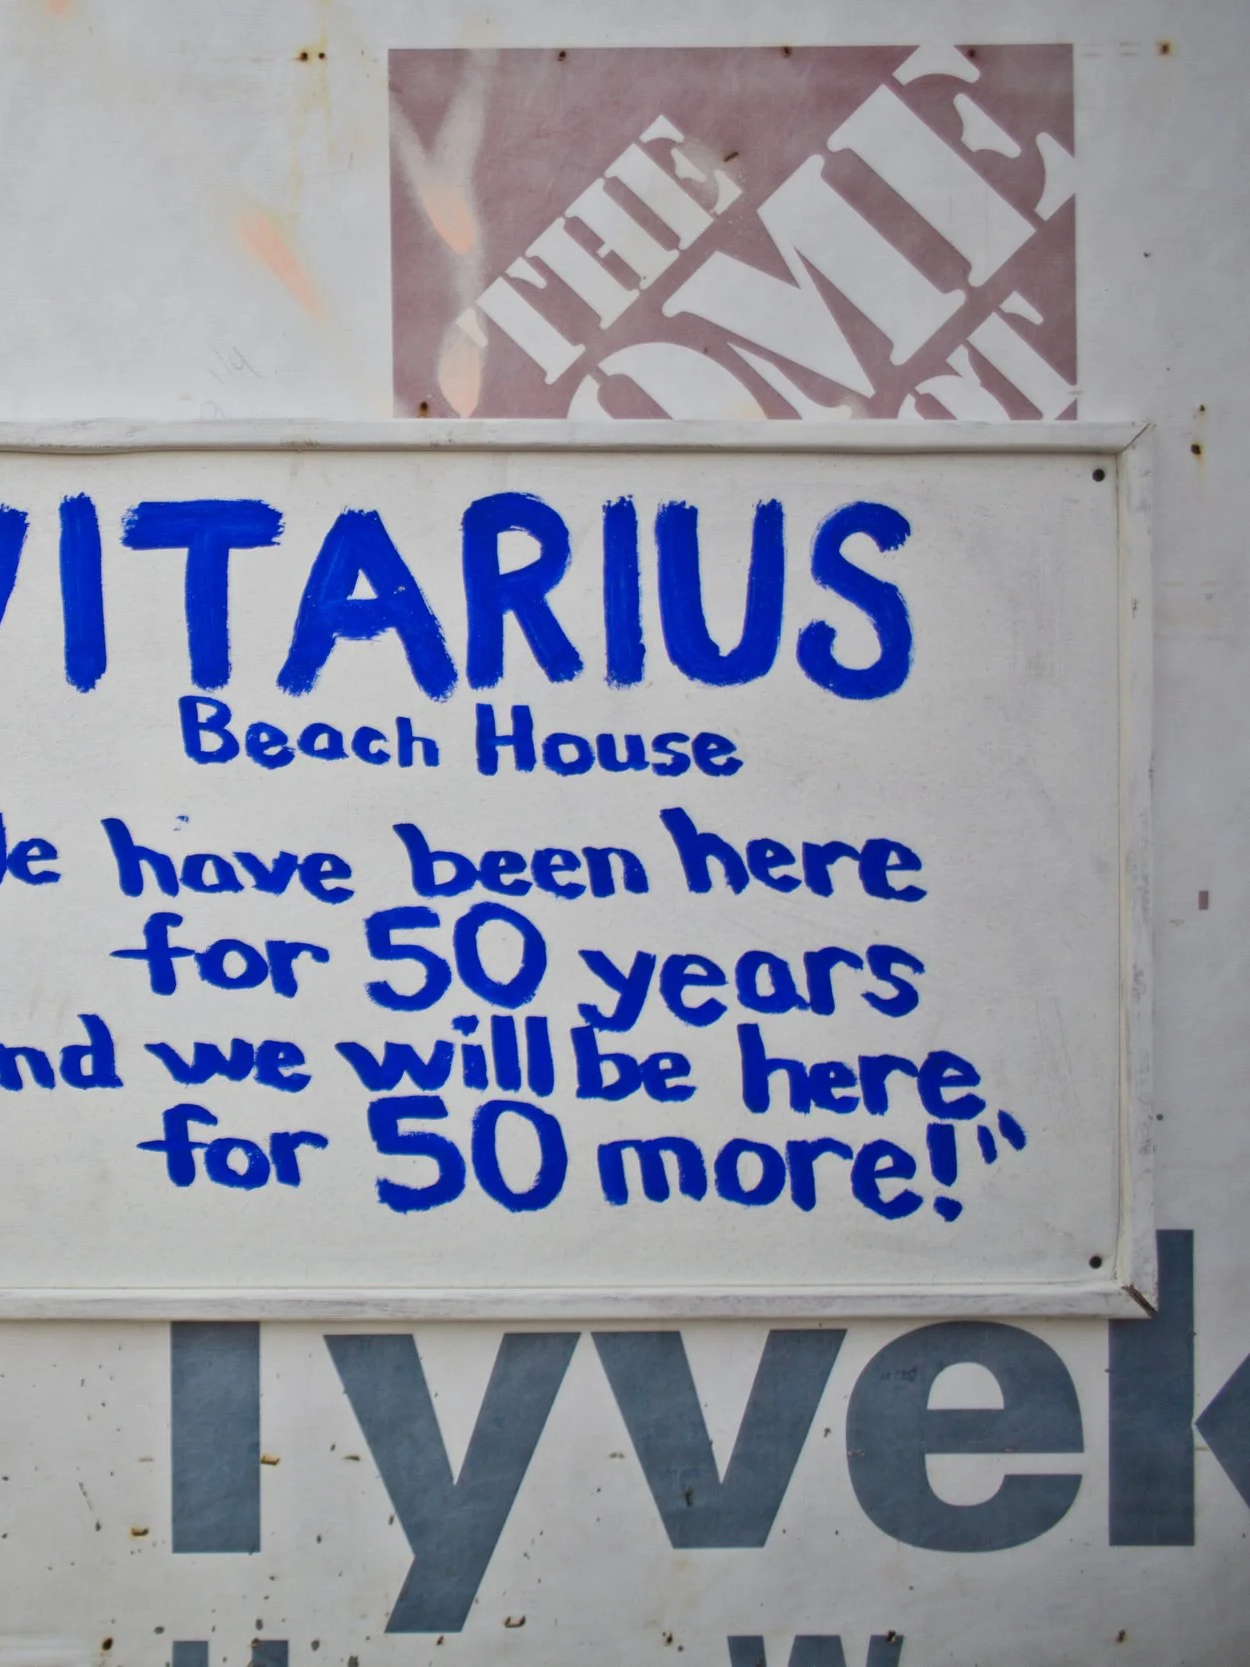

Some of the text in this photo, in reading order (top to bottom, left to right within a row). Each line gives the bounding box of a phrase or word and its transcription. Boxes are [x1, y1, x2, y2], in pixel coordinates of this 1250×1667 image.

[456, 114, 743, 385] THE
[178, 695, 744, 777] Beach House
[101, 817, 355, 905] have
[393, 823, 650, 901] been
[660, 806, 927, 903] here
[110, 900, 926, 1034] for 50 years
[144, 1037, 312, 1094] we
[335, 1014, 555, 1098] will
[571, 1028, 697, 1103] be
[737, 1023, 987, 1121] here
[137, 1103, 329, 1191] for
[367, 1094, 569, 1214] 50
